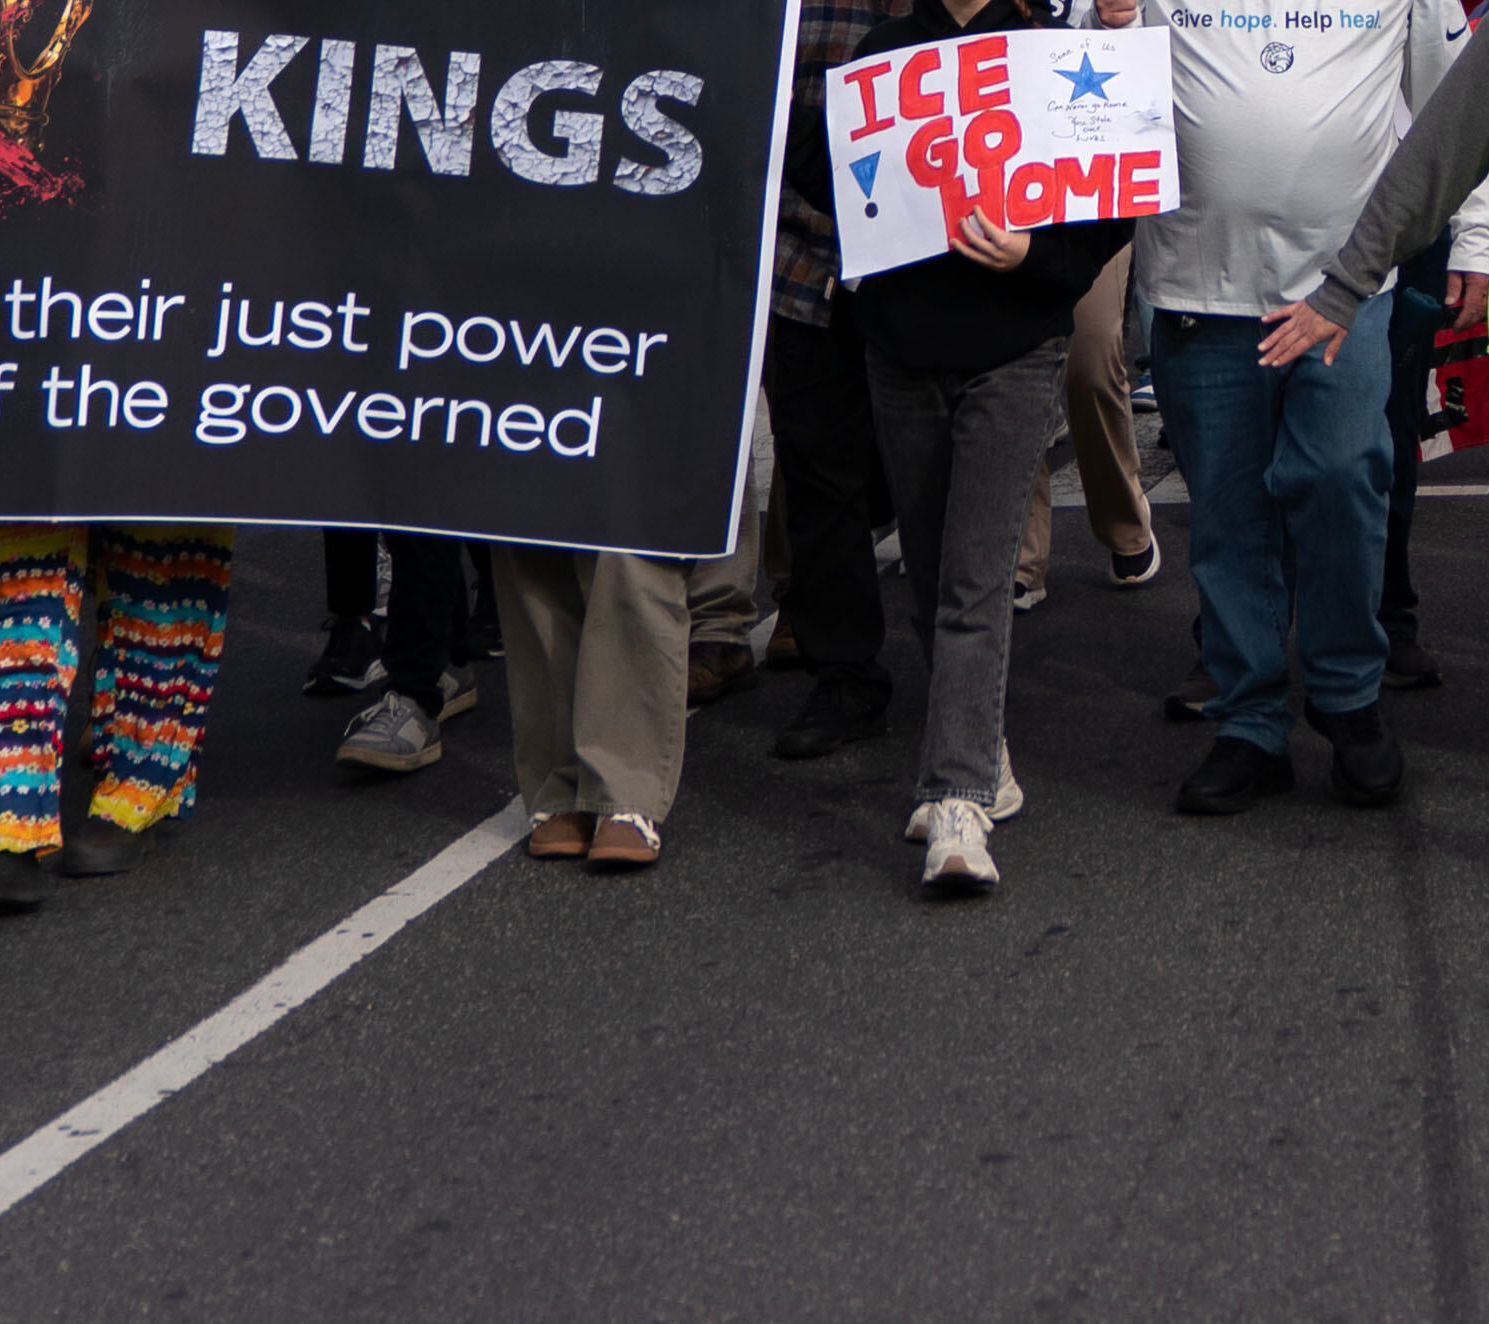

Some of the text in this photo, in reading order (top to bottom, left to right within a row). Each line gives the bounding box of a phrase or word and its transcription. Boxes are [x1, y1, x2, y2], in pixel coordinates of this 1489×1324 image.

[1170, 8, 1382, 33] Give hope. Help heal.
[191, 29, 704, 197] KINGS
[843, 34, 1011, 142] ICE
[905, 109, 1022, 189] GO
[938, 150, 1162, 251] HOME
[4, 277, 186, 344] their
[206, 282, 371, 357] just
[398, 308, 669, 378] power
[43, 363, 169, 431] the
[195, 381, 604, 459] governed
